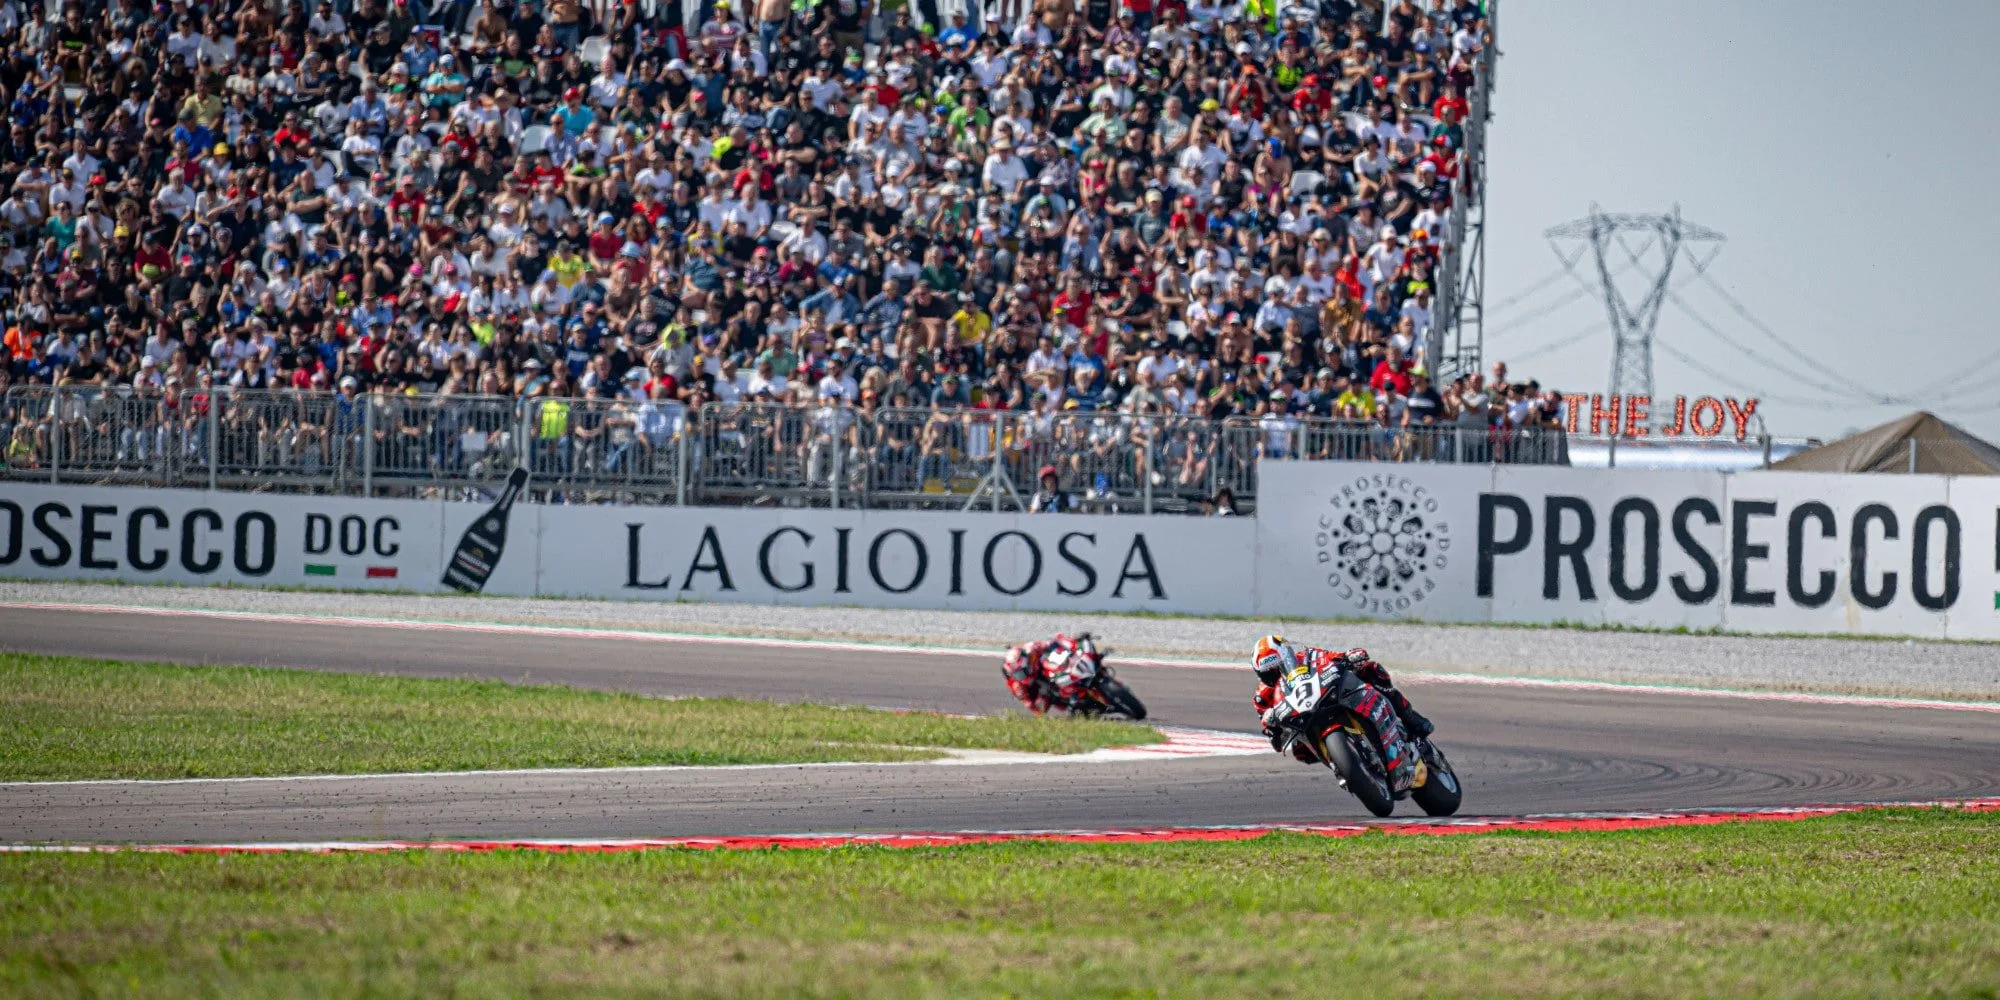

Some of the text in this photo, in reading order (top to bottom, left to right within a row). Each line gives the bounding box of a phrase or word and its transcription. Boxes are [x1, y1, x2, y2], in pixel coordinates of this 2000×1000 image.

[1562, 393, 1759, 441] THE JOY
[1330, 474, 1438, 513] PROSECCO
[304, 512, 400, 556] DOC
[1476, 493, 1961, 611] PROSECCO
[1327, 572, 1435, 613] PROSECCO
